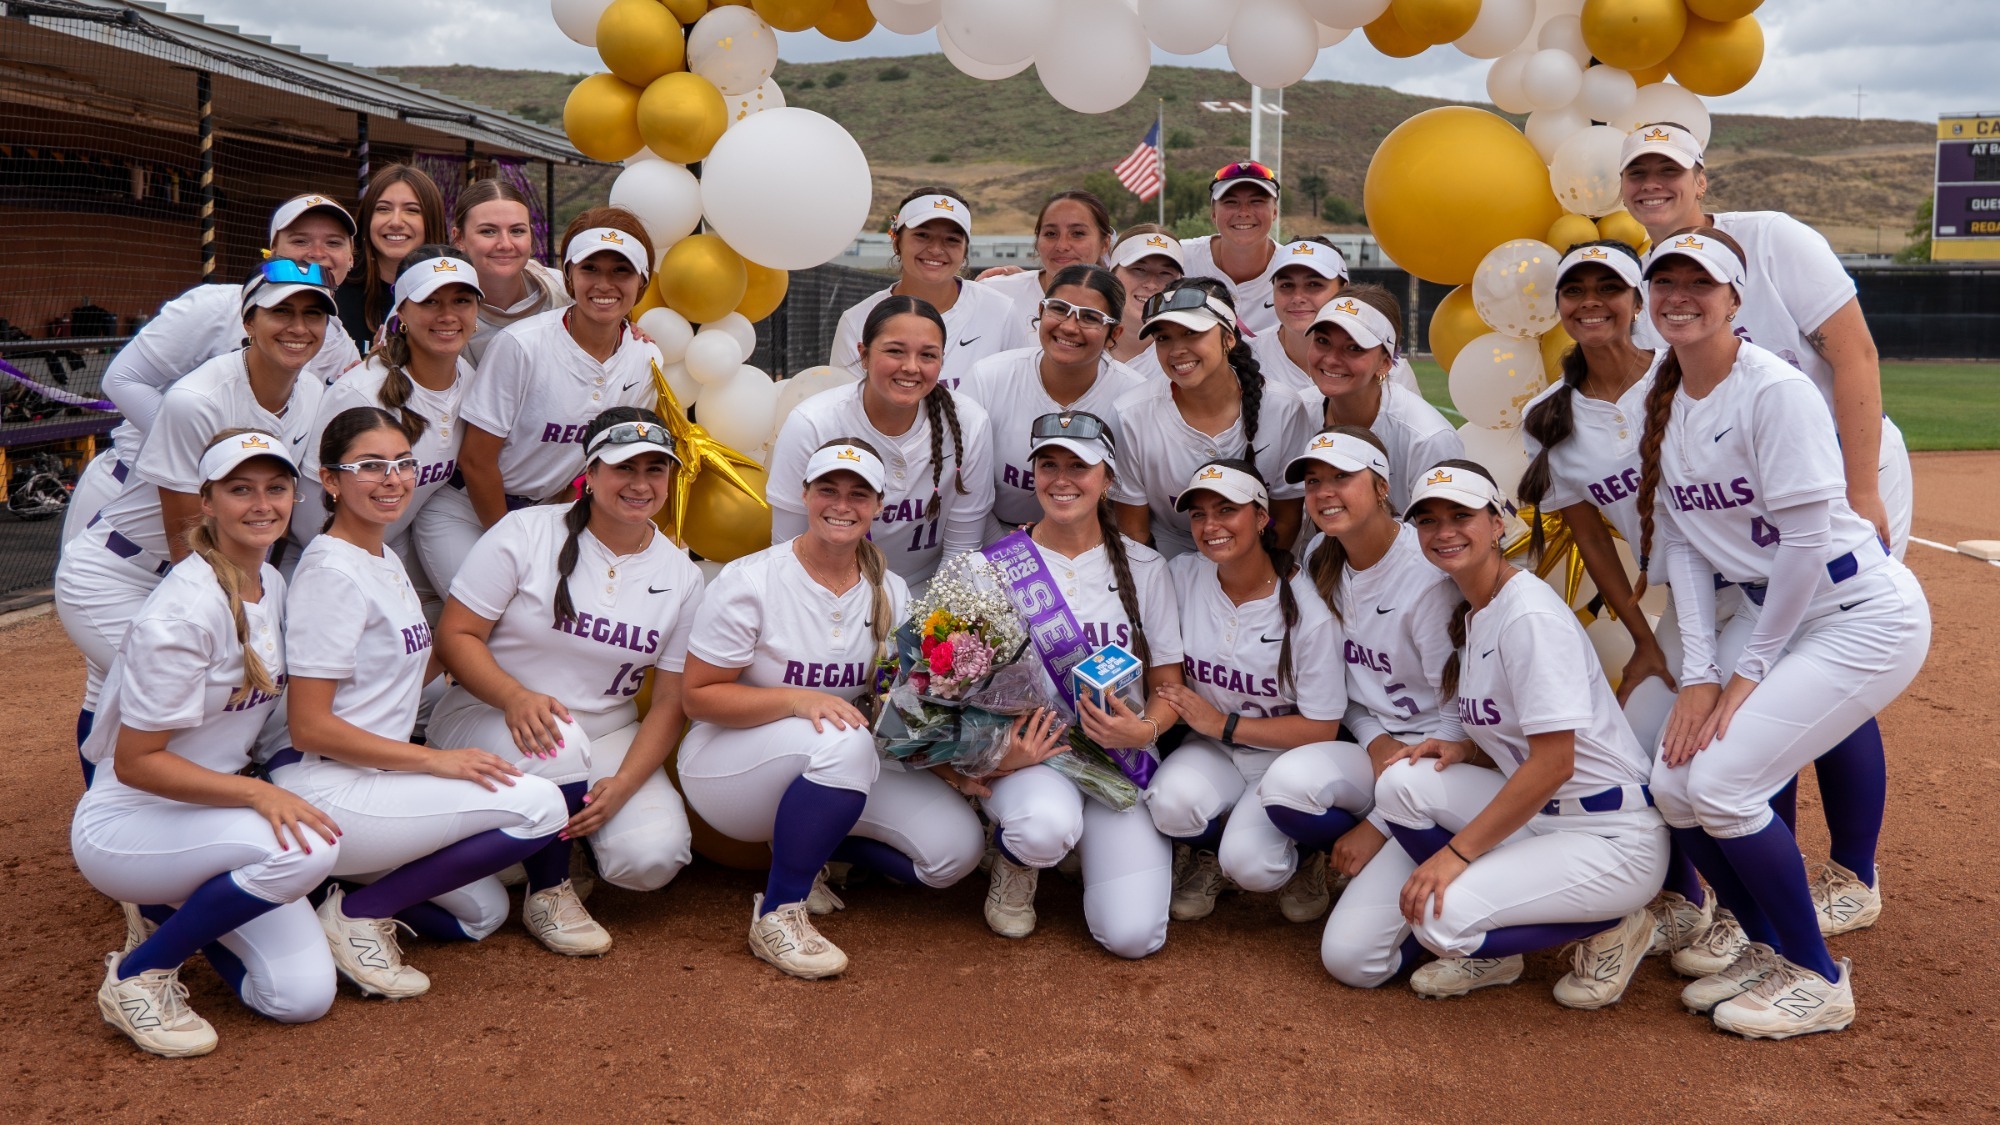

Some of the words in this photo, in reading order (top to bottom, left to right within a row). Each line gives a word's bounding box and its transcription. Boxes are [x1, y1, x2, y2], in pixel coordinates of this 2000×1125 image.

[1971, 144, 1988, 156] AT
[1989, 143, 2000, 155] B
[1971, 198, 2000, 211] GUE
[414, 459, 455, 488] EGA
[872, 495, 942, 524] GAL
[906, 517, 939, 552] 11
[991, 541, 1027, 561] CLASS
[1001, 558, 1040, 585] 2026
[551, 611, 660, 654] REGALS
[1183, 653, 1278, 697] REGALS
[349, 937, 390, 970] N
[762, 929, 796, 957] N
[119, 998, 162, 1030] N
[1773, 988, 1825, 1018] N
